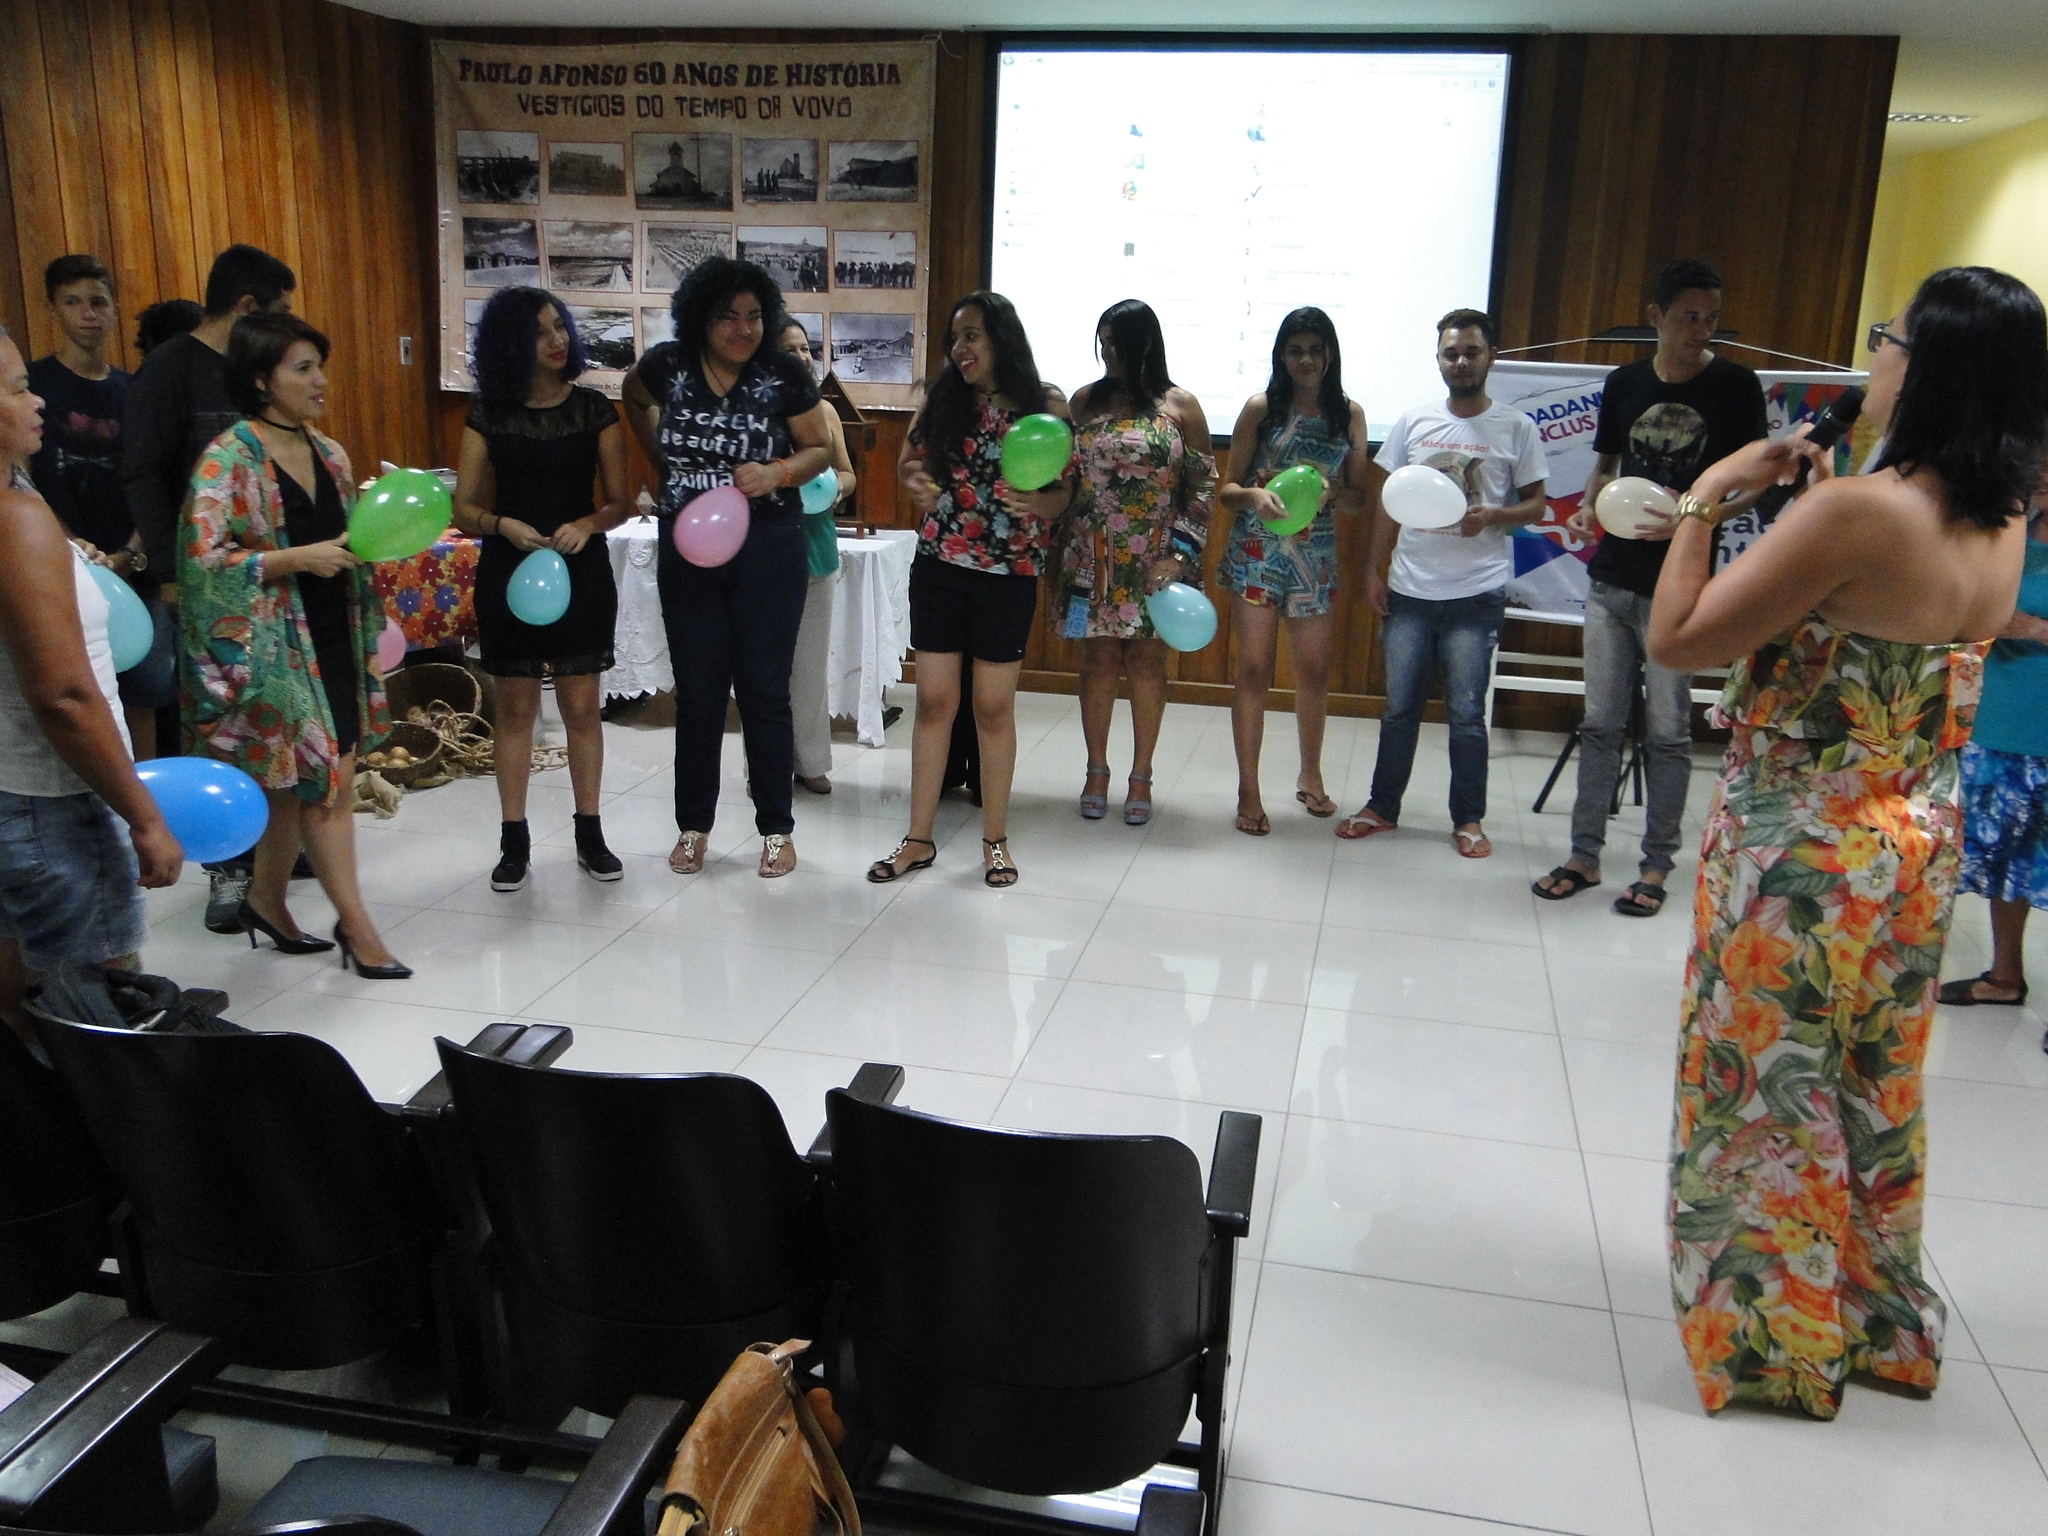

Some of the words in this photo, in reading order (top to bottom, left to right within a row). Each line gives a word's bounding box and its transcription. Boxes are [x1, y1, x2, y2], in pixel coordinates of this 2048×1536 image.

[458, 59, 533, 85] PAULO
[538, 63, 628, 87] AFONSO
[633, 61, 666, 85] 60
[672, 62, 739, 87] ANOS
[745, 64, 779, 87] DE
[785, 60, 901, 88] HISTÓRIA
[637, 95, 664, 118] DO
[675, 95, 748, 119] TEMPO
